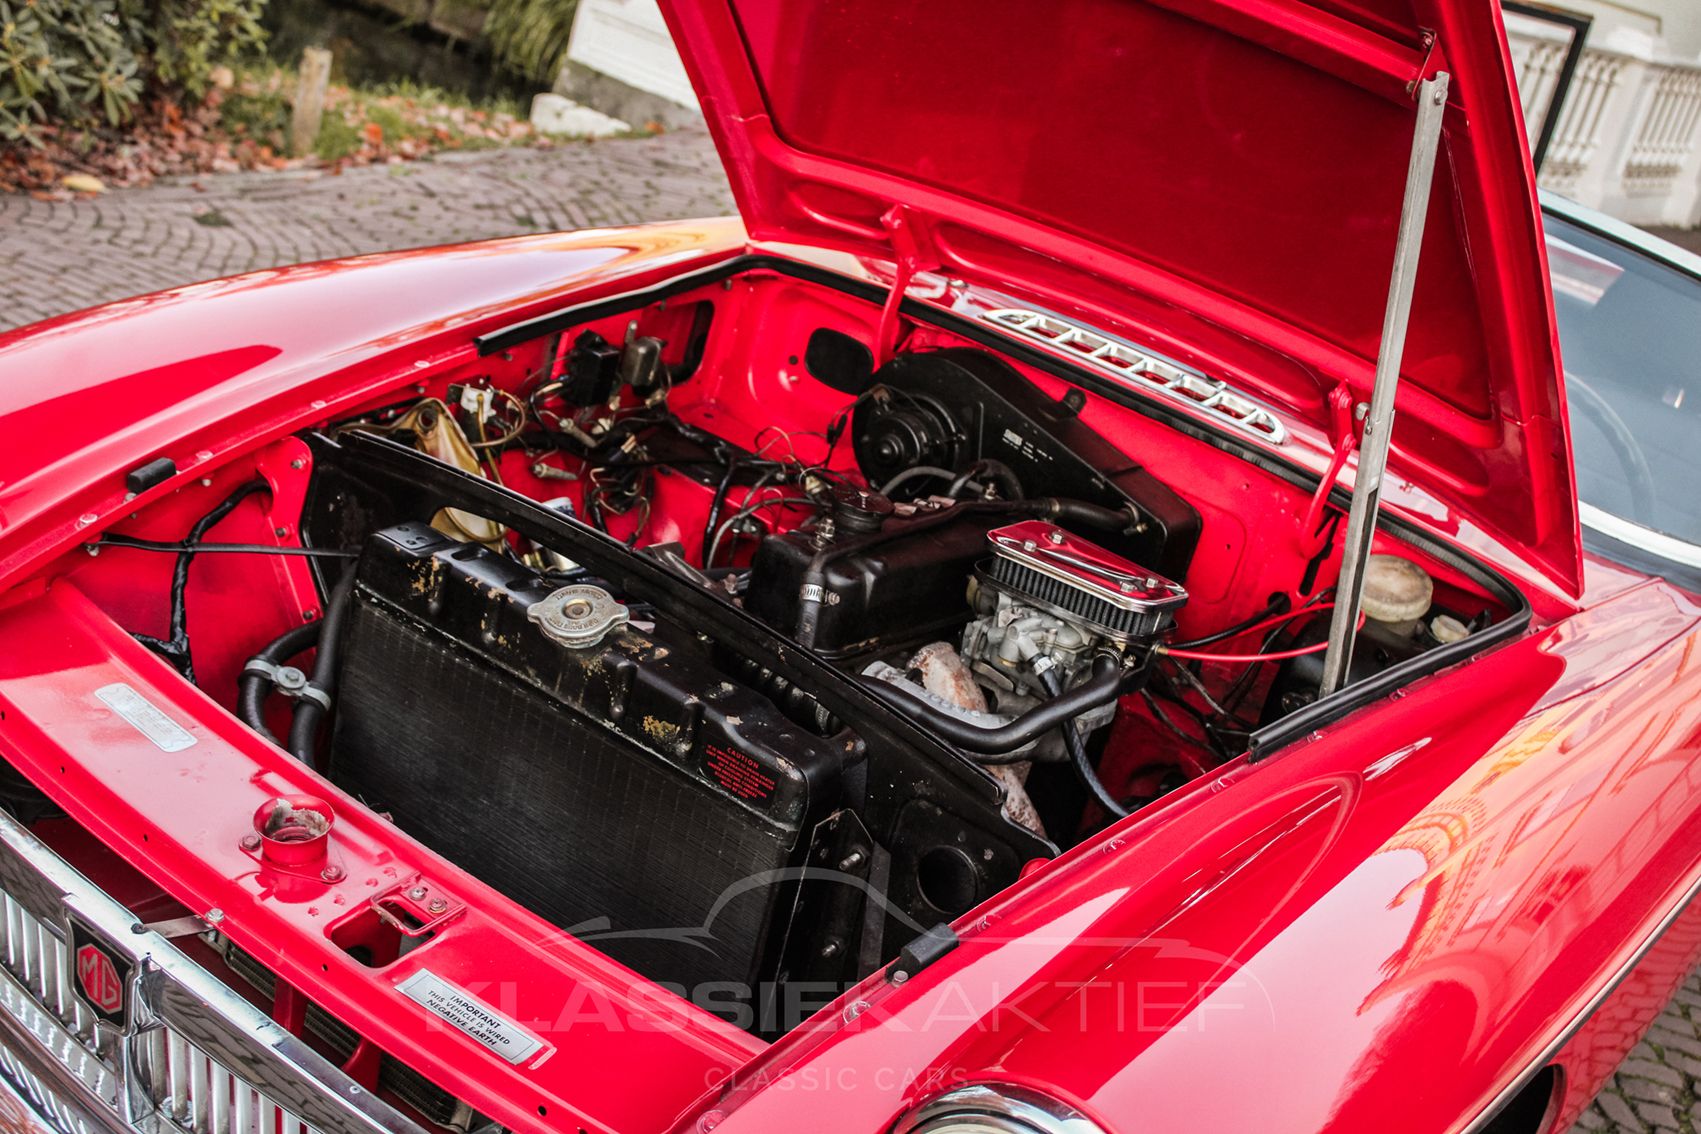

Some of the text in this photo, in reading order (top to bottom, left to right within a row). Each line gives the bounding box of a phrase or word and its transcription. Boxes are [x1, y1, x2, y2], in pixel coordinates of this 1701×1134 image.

[727, 747, 759, 769] CAUTION
[81, 953, 118, 1005] MG
[426, 999, 498, 1046] NEGATIVE EARTH
[428, 990, 511, 1045] THIS VEHICLE IS WIRED
[450, 995, 501, 1029] IMPORTANT
